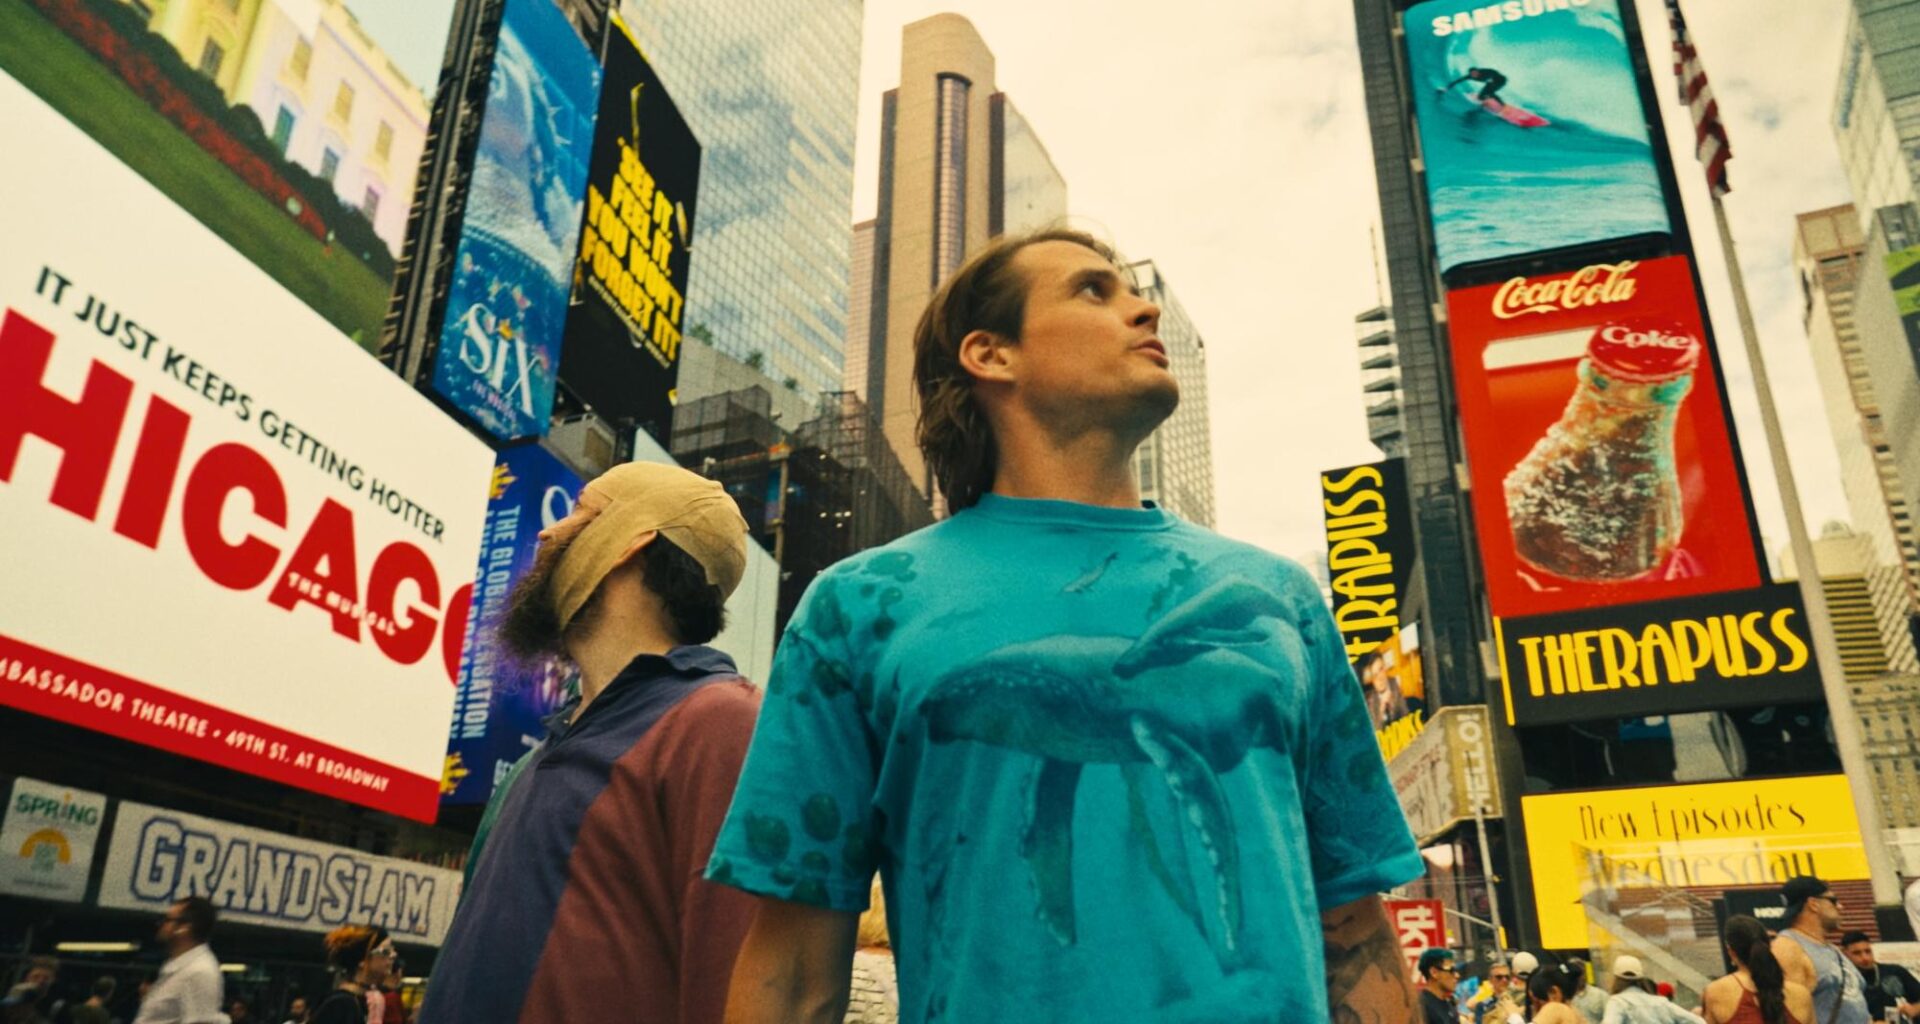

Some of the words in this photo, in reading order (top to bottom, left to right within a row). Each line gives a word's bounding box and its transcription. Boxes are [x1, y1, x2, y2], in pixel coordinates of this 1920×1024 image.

[588, 184, 629, 258] YOU
[581, 225, 655, 331] FORGET
[1492, 259, 1640, 319] Coca-Cola
[1601, 326, 1691, 349] Coke
[36, 265, 72, 305] IT
[75, 294, 159, 360] JUST
[162, 346, 252, 422] KEEPS
[259, 410, 364, 491] GETTING
[369, 479, 445, 543] HOTTER
[493, 504, 521, 544] THE
[289, 571, 322, 600] THE
[325, 591, 396, 637] MUSICAL
[1518, 608, 1809, 696] THERAPUSS
[130, 698, 209, 738] THEATRE
[225, 729, 266, 755] 49TH
[269, 742, 290, 763] ST.
[294, 751, 315, 771] AT
[316, 757, 389, 793] BROADWAY
[1457, 713, 1493, 812] HELLO!
